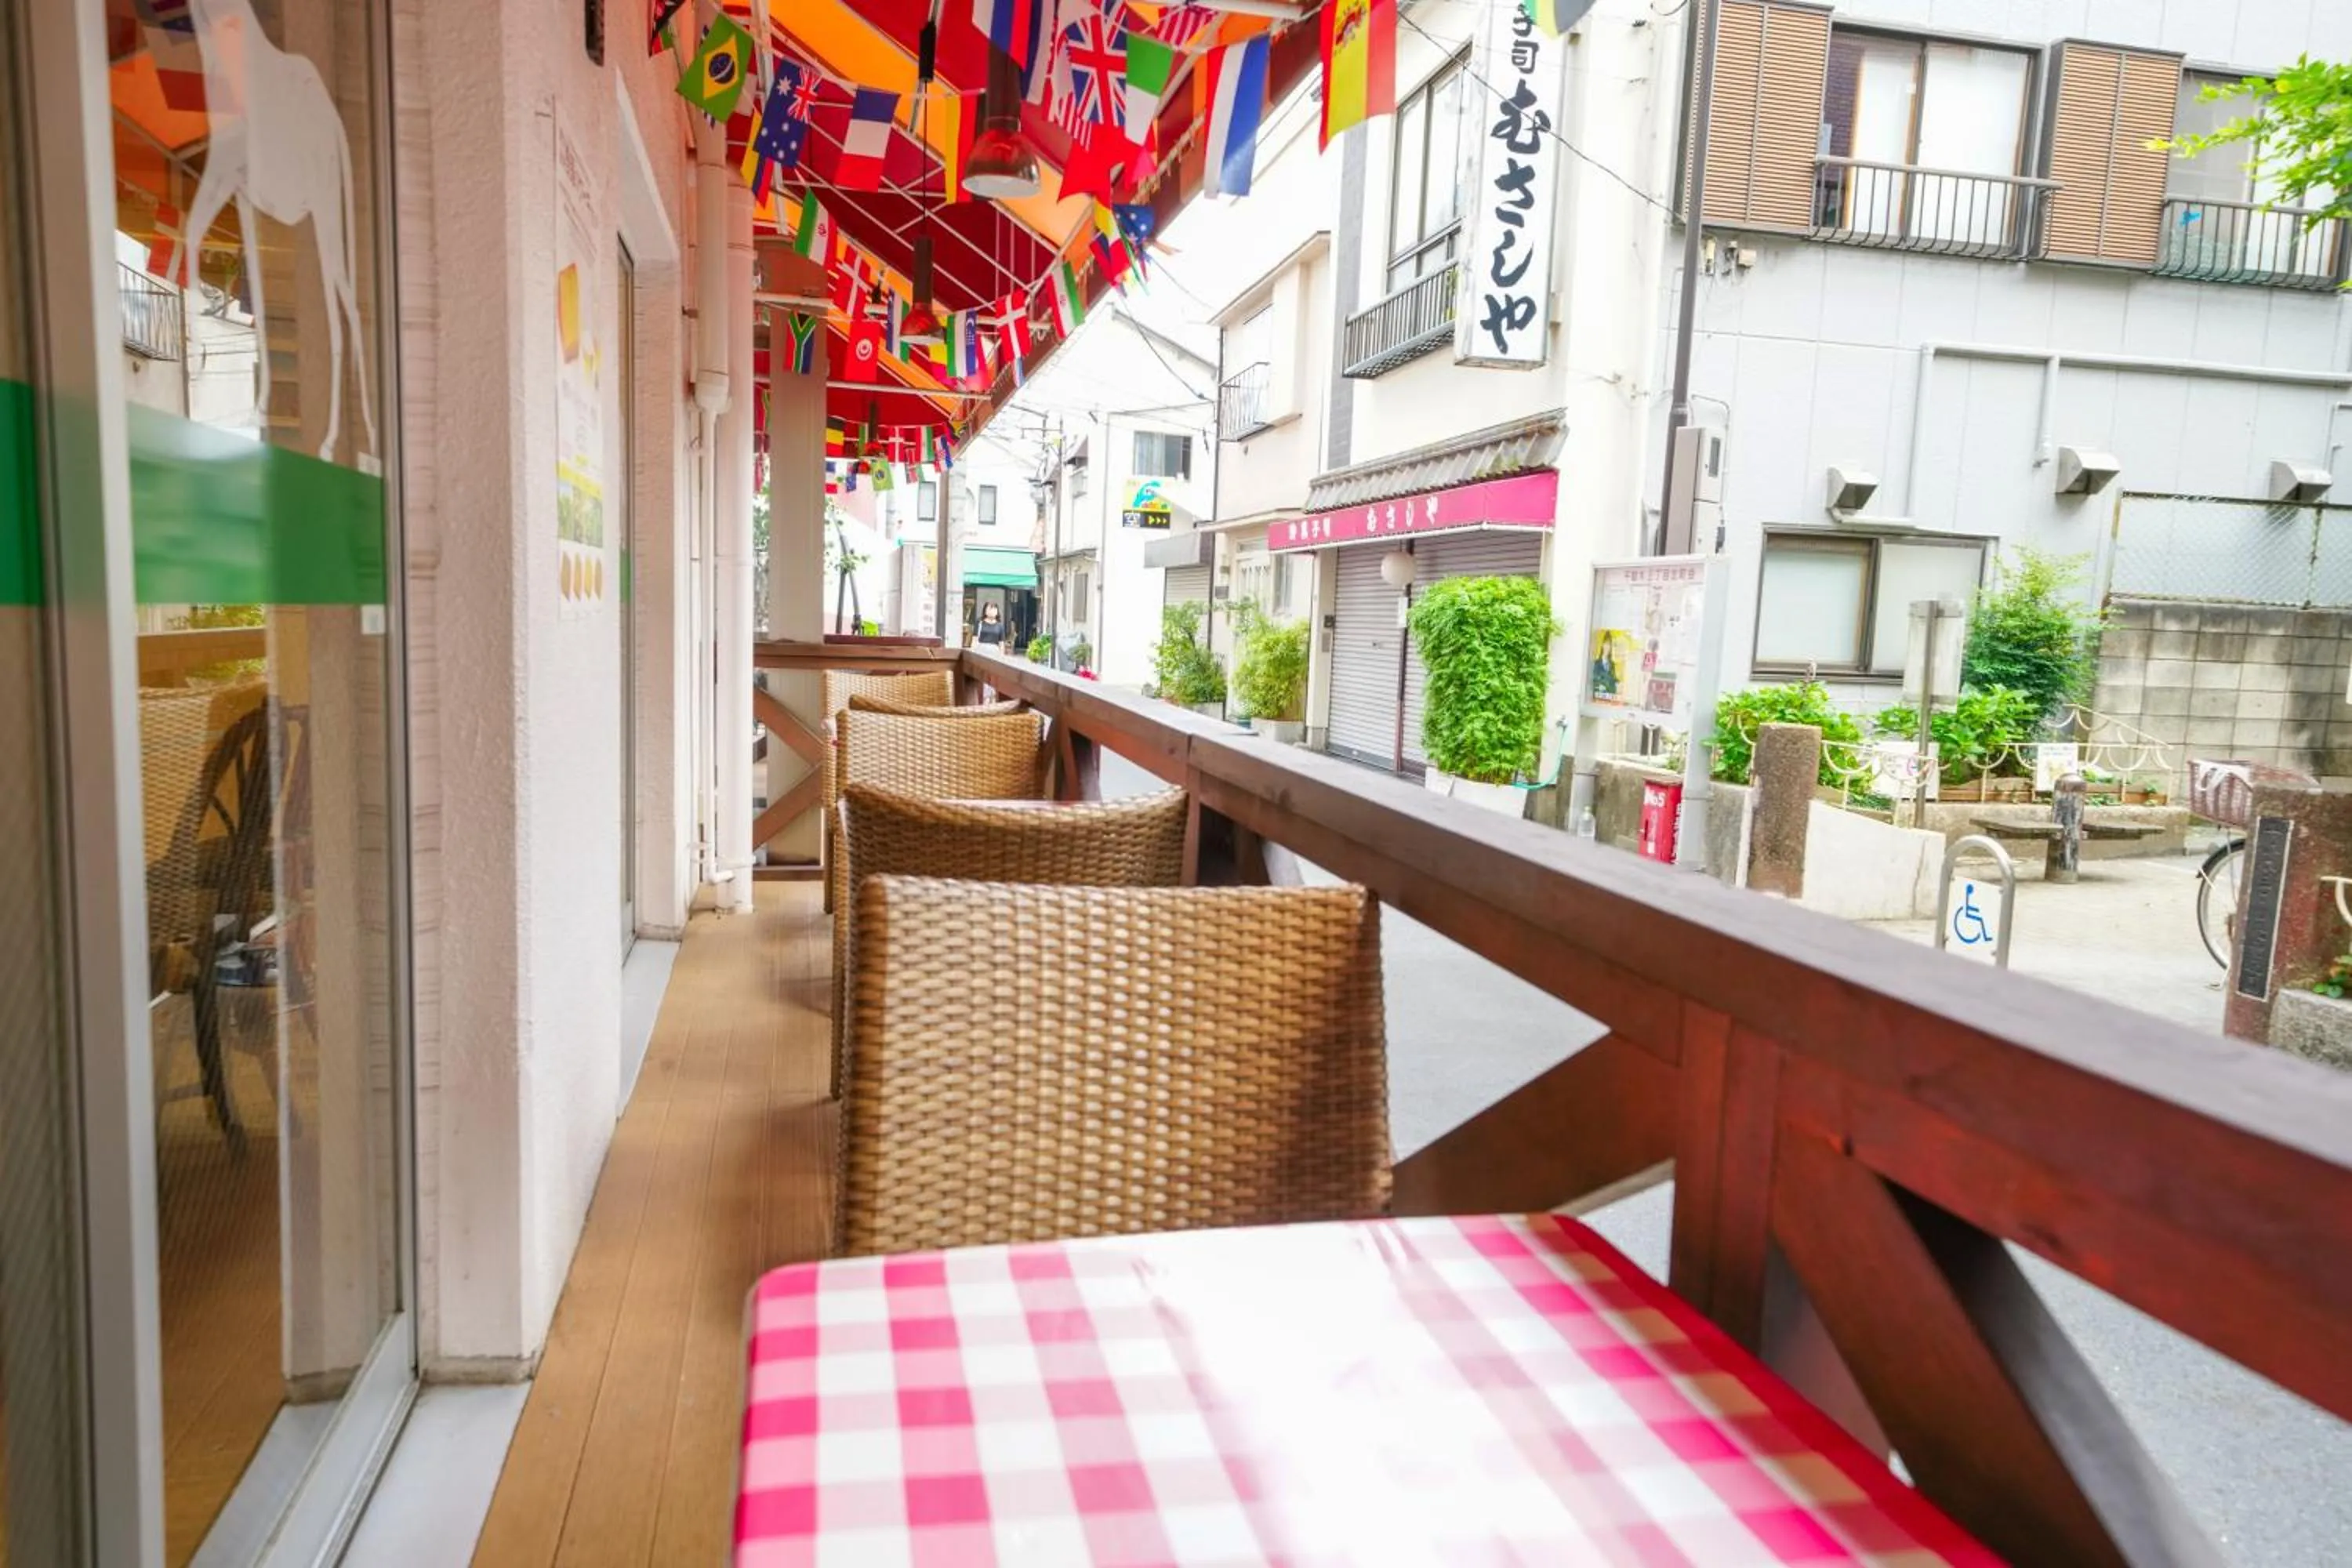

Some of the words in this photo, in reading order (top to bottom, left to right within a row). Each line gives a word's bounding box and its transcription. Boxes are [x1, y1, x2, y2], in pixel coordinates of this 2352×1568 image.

[1480, 78, 1552, 354] むさしや
[1367, 495, 1439, 532] むさしや
